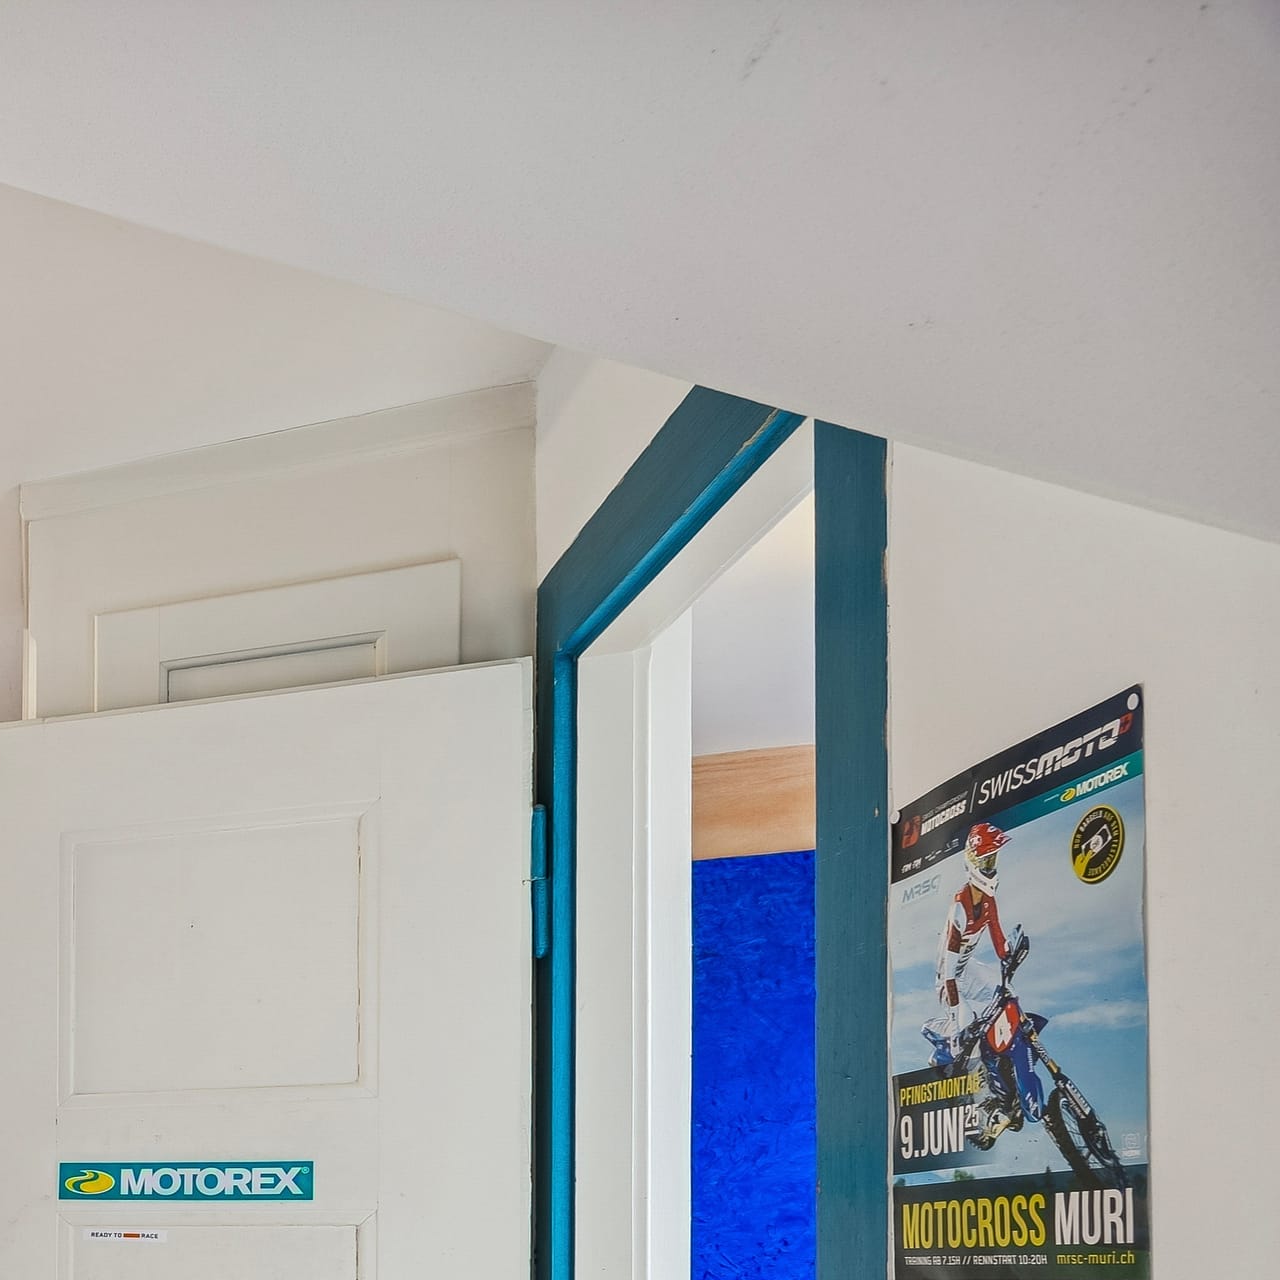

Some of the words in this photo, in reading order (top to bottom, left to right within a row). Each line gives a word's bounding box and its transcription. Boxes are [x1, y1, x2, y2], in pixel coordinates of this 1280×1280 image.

[1076, 761, 1130, 797] MOTOREX
[920, 798, 967, 836] MOTOCROSS
[899, 1073, 981, 1107] PFINGSTMONTAG
[120, 1166, 304, 1195] MOTOREX
[902, 1193, 1046, 1250] MOTOCROSS
[1054, 1187, 1135, 1246] MURI
[113, 1231, 122, 1239] TO
[972, 1254, 1017, 1265] RENNSTART
[1056, 1250, 1135, 1264] mrsc-muri.ch
